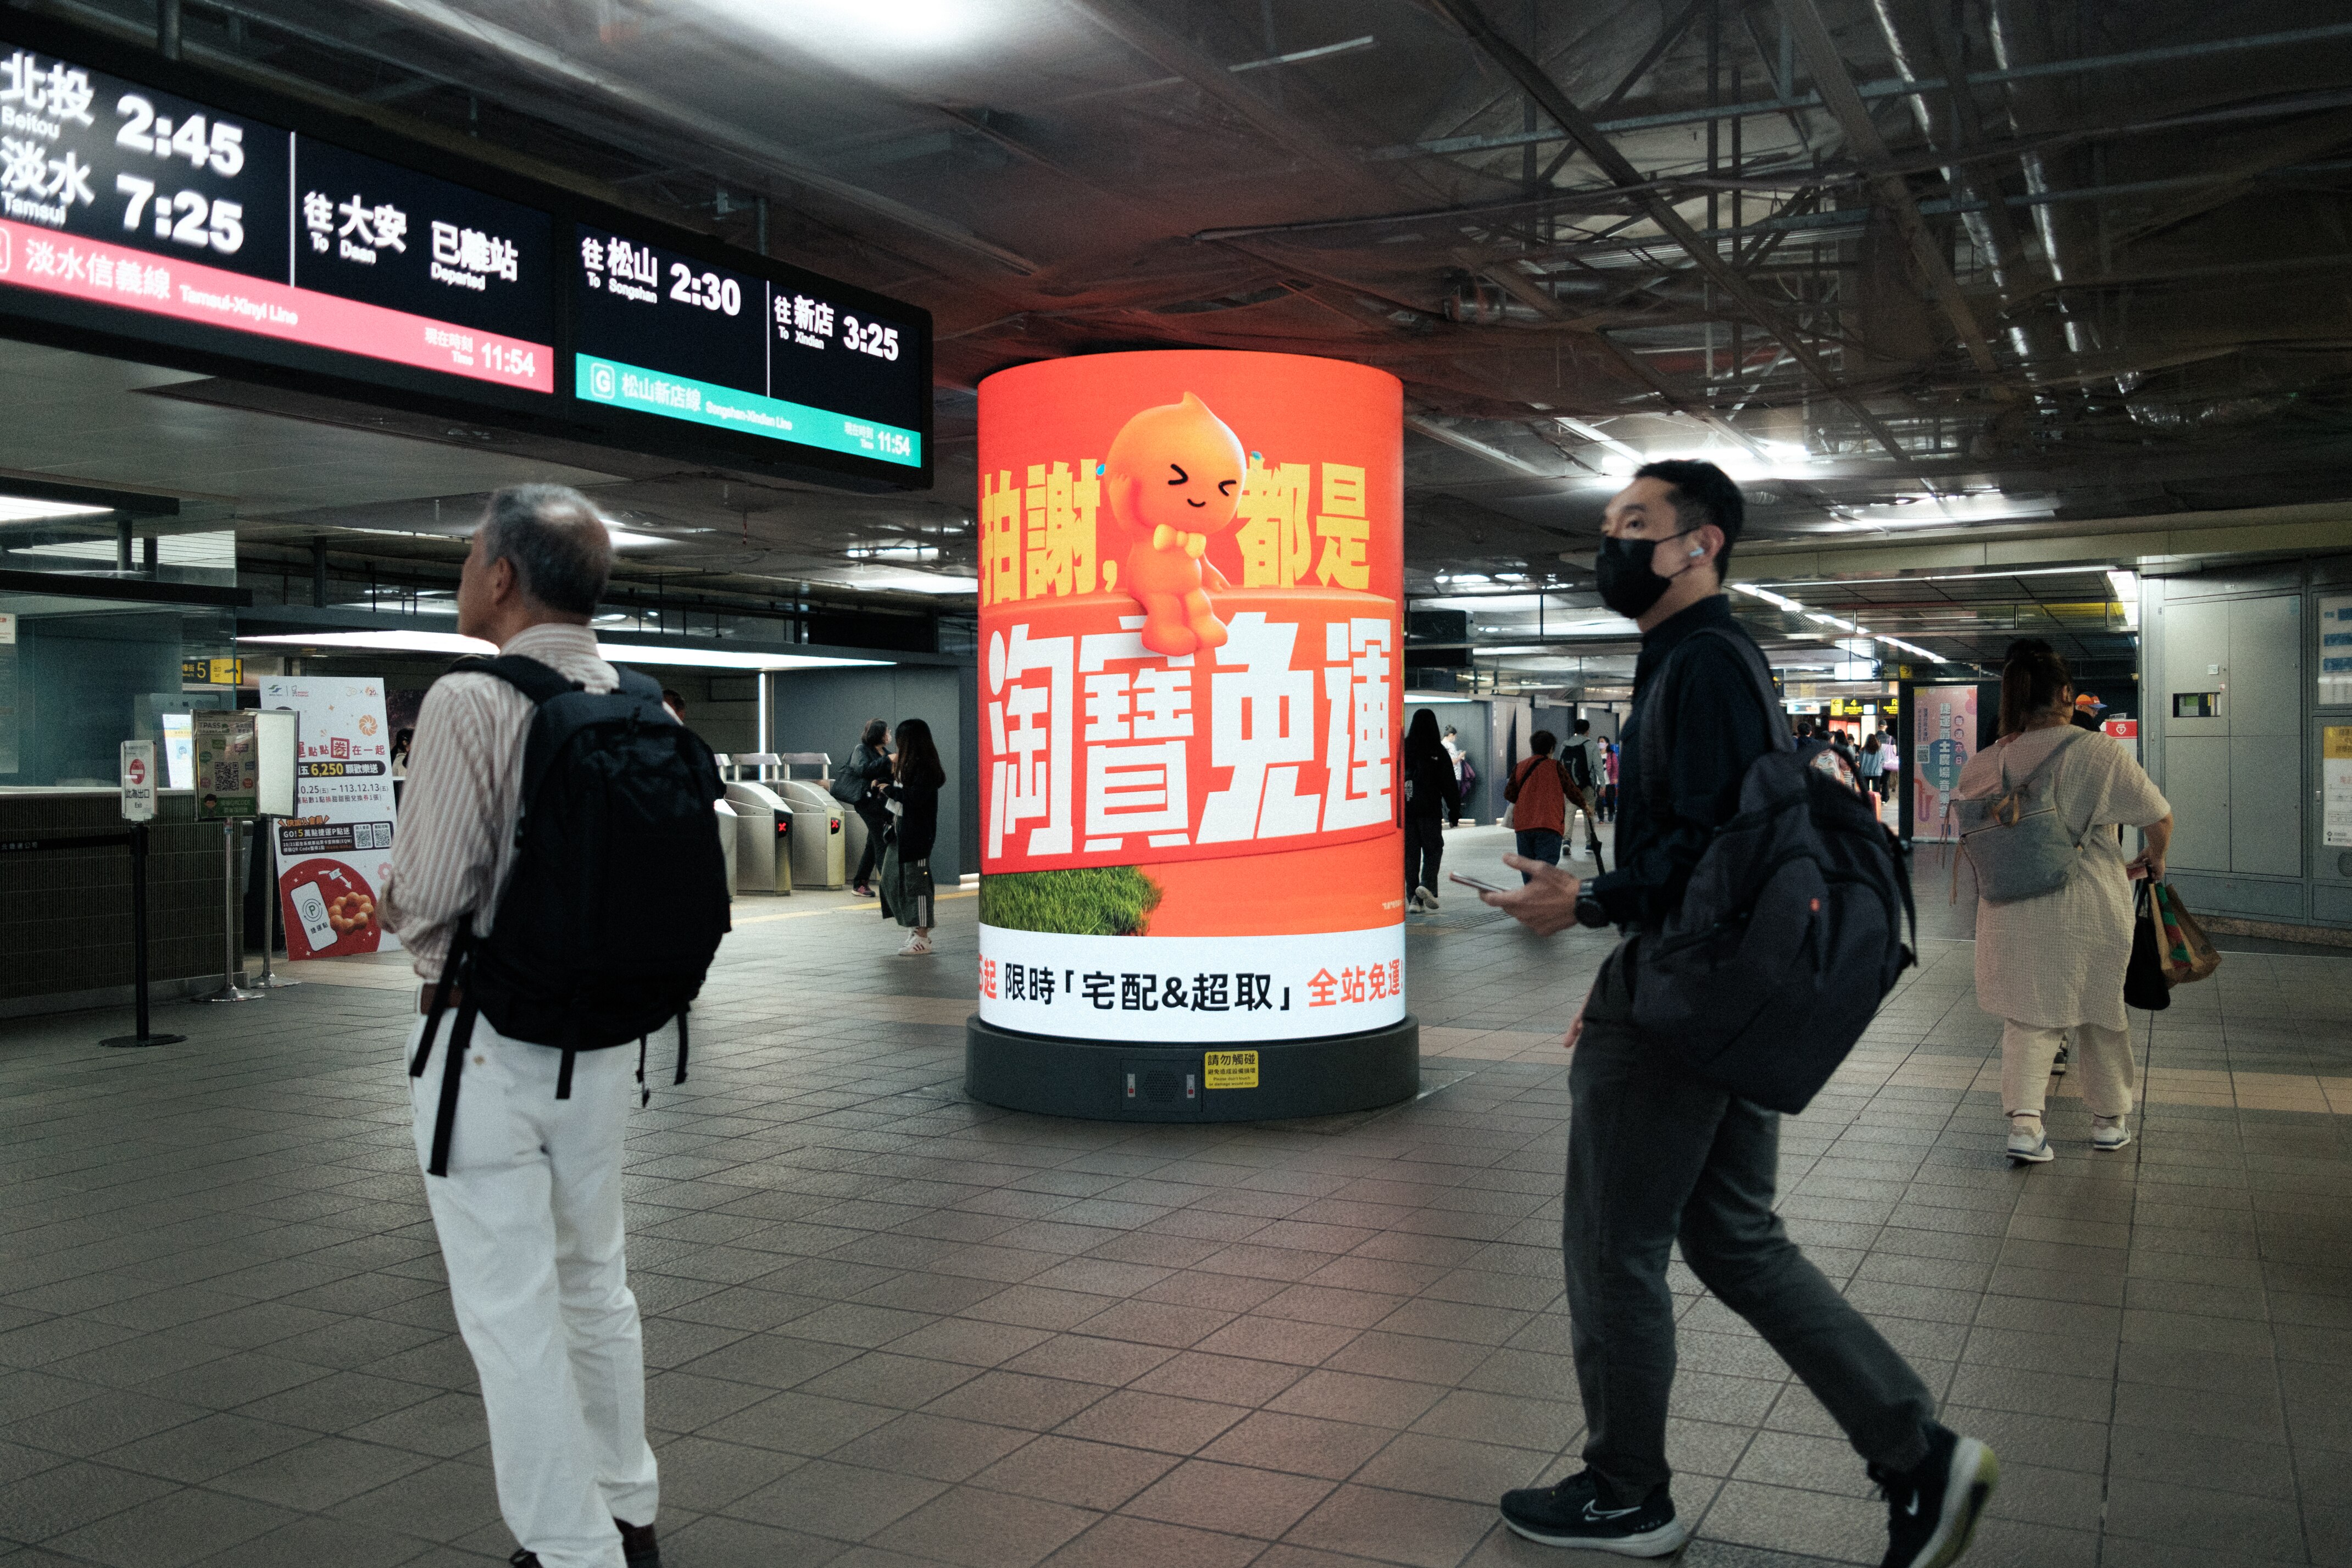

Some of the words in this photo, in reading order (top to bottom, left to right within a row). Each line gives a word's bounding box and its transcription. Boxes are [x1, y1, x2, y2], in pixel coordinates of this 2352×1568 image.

[0, 52, 94, 125] 北投
[116, 94, 244, 176] 2:45
[2, 105, 60, 140] Beitou
[0, 136, 94, 206] 淡水
[116, 174, 244, 254] 7:25
[1, 191, 66, 226] Tamsui
[304, 191, 333, 232] 往
[338, 194, 407, 253] 大安
[431, 220, 518, 282] 已離站
[26, 239, 171, 299] 淡水信義線
[311, 231, 329, 253] To
[339, 239, 377, 264] Daan
[431, 262, 486, 291] Departed
[582, 237, 604, 271] 往
[607, 237, 657, 287] 松山
[670, 263, 741, 316] 2:30
[180, 285, 267, 321] Tamsui-Xinyi
[270, 305, 298, 325] Line
[587, 271, 601, 288] To
[608, 277, 657, 304] Songshan
[774, 295, 792, 324] 往
[794, 294, 835, 337] 新店
[843, 316, 899, 361] 3:25
[778, 325, 789, 340] To
[795, 330, 824, 350] Xindian
[424, 327, 474, 353] 現在時刻
[481, 342, 535, 377] 11:54
[596, 369, 611, 393] G
[622, 372, 701, 412] 松山新店線
[776, 416, 793, 431] Line
[878, 431, 910, 457] 11:54
[1235, 457, 1370, 590] 都是
[197, 661, 206, 679] 5
[988, 611, 1392, 859] 淘寶免運
[298, 762, 379, 776] 五6,250顆歡樂送
[125, 789, 150, 798] 此為出口
[298, 785, 329, 794] 0.25(五)
[340, 783, 389, 792] 113.12.13(五)
[1208, 1053, 1255, 1066] 請勿觸碰
